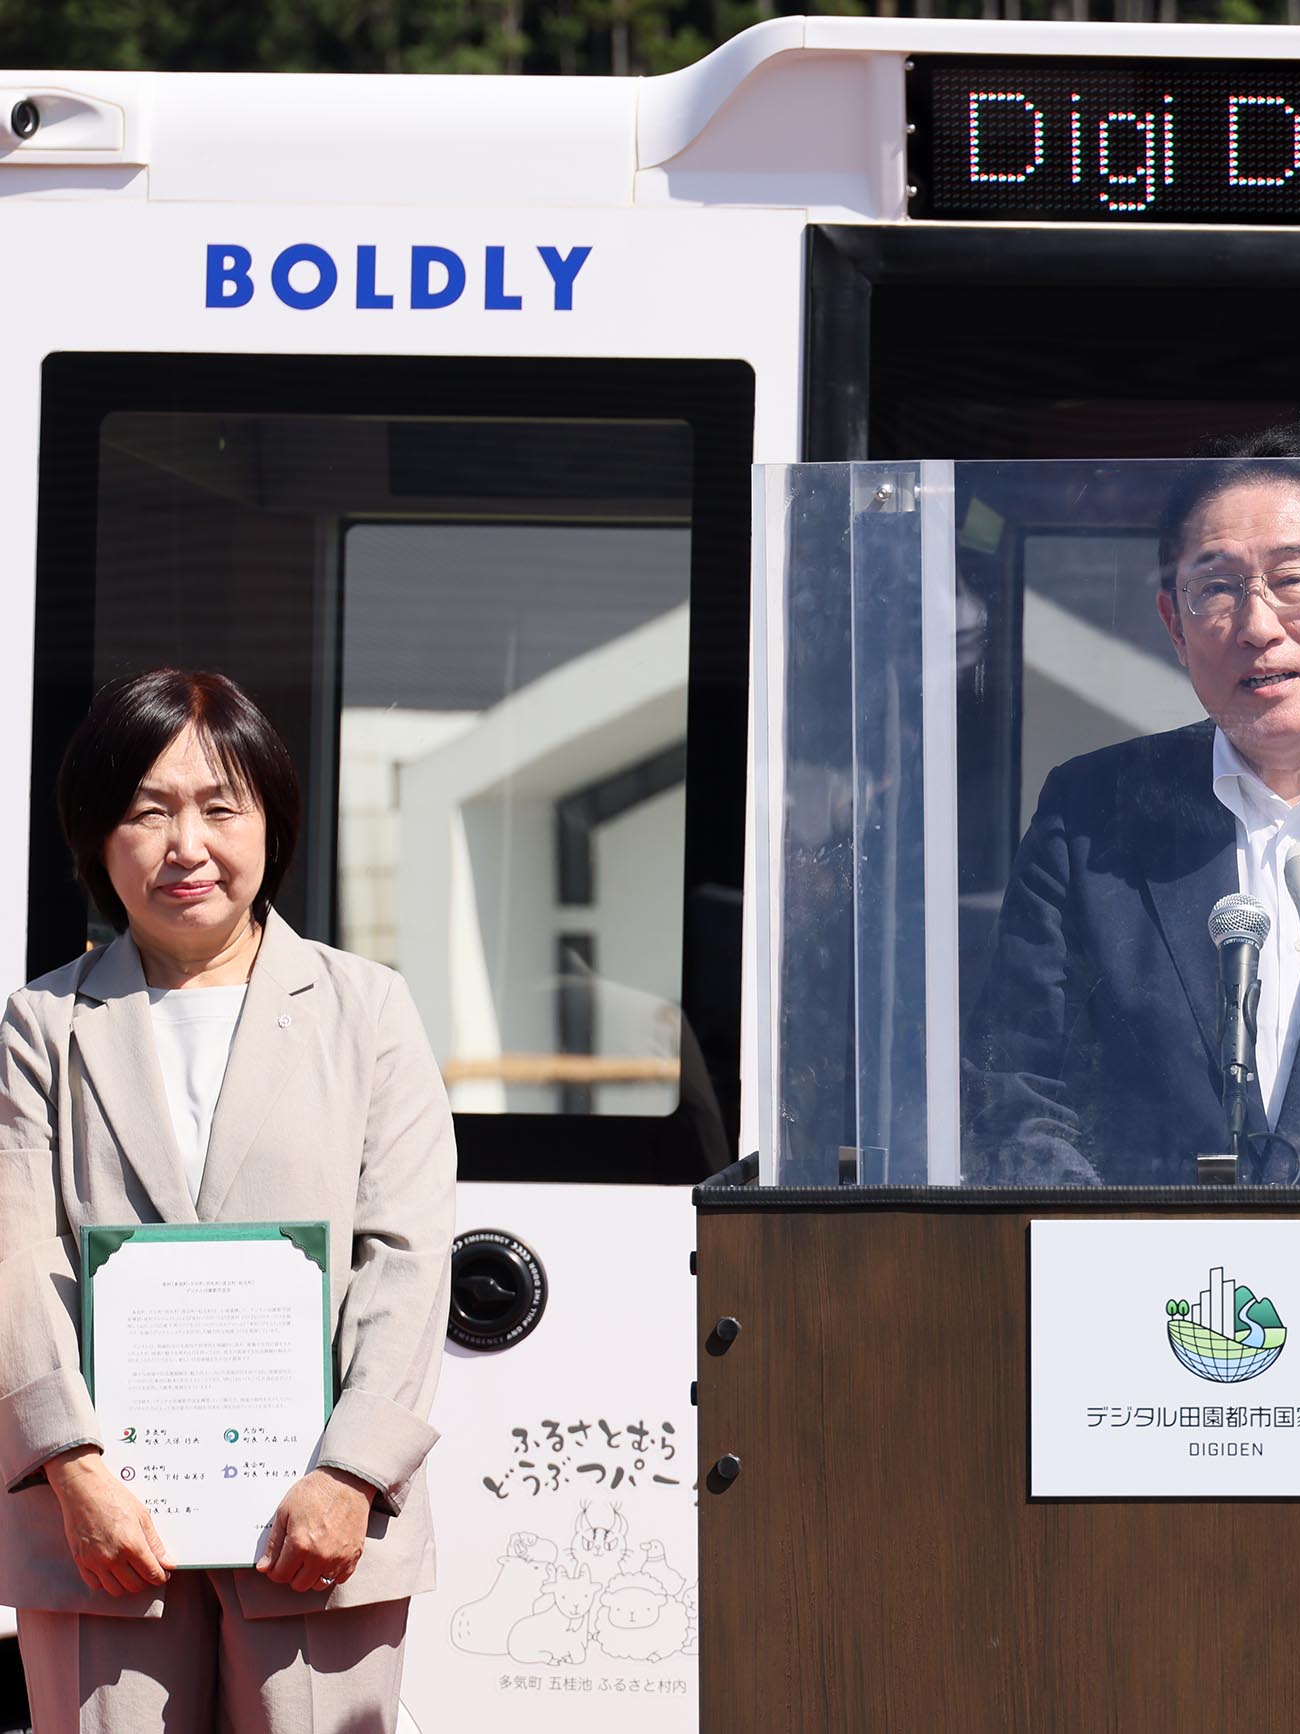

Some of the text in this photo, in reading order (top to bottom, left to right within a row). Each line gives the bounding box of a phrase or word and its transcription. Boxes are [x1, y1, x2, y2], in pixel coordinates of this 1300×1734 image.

[970, 91, 1176, 210] Digi
[205, 243, 593, 311] BOLDLY
[464, 1233, 510, 1245] EMERGENCY
[511, 1419, 676, 1461] ふるさとむら
[1188, 1442, 1264, 1457] DIGIDEN
[499, 1674, 687, 1694] 多気町 五桂池 ふるさと村内
